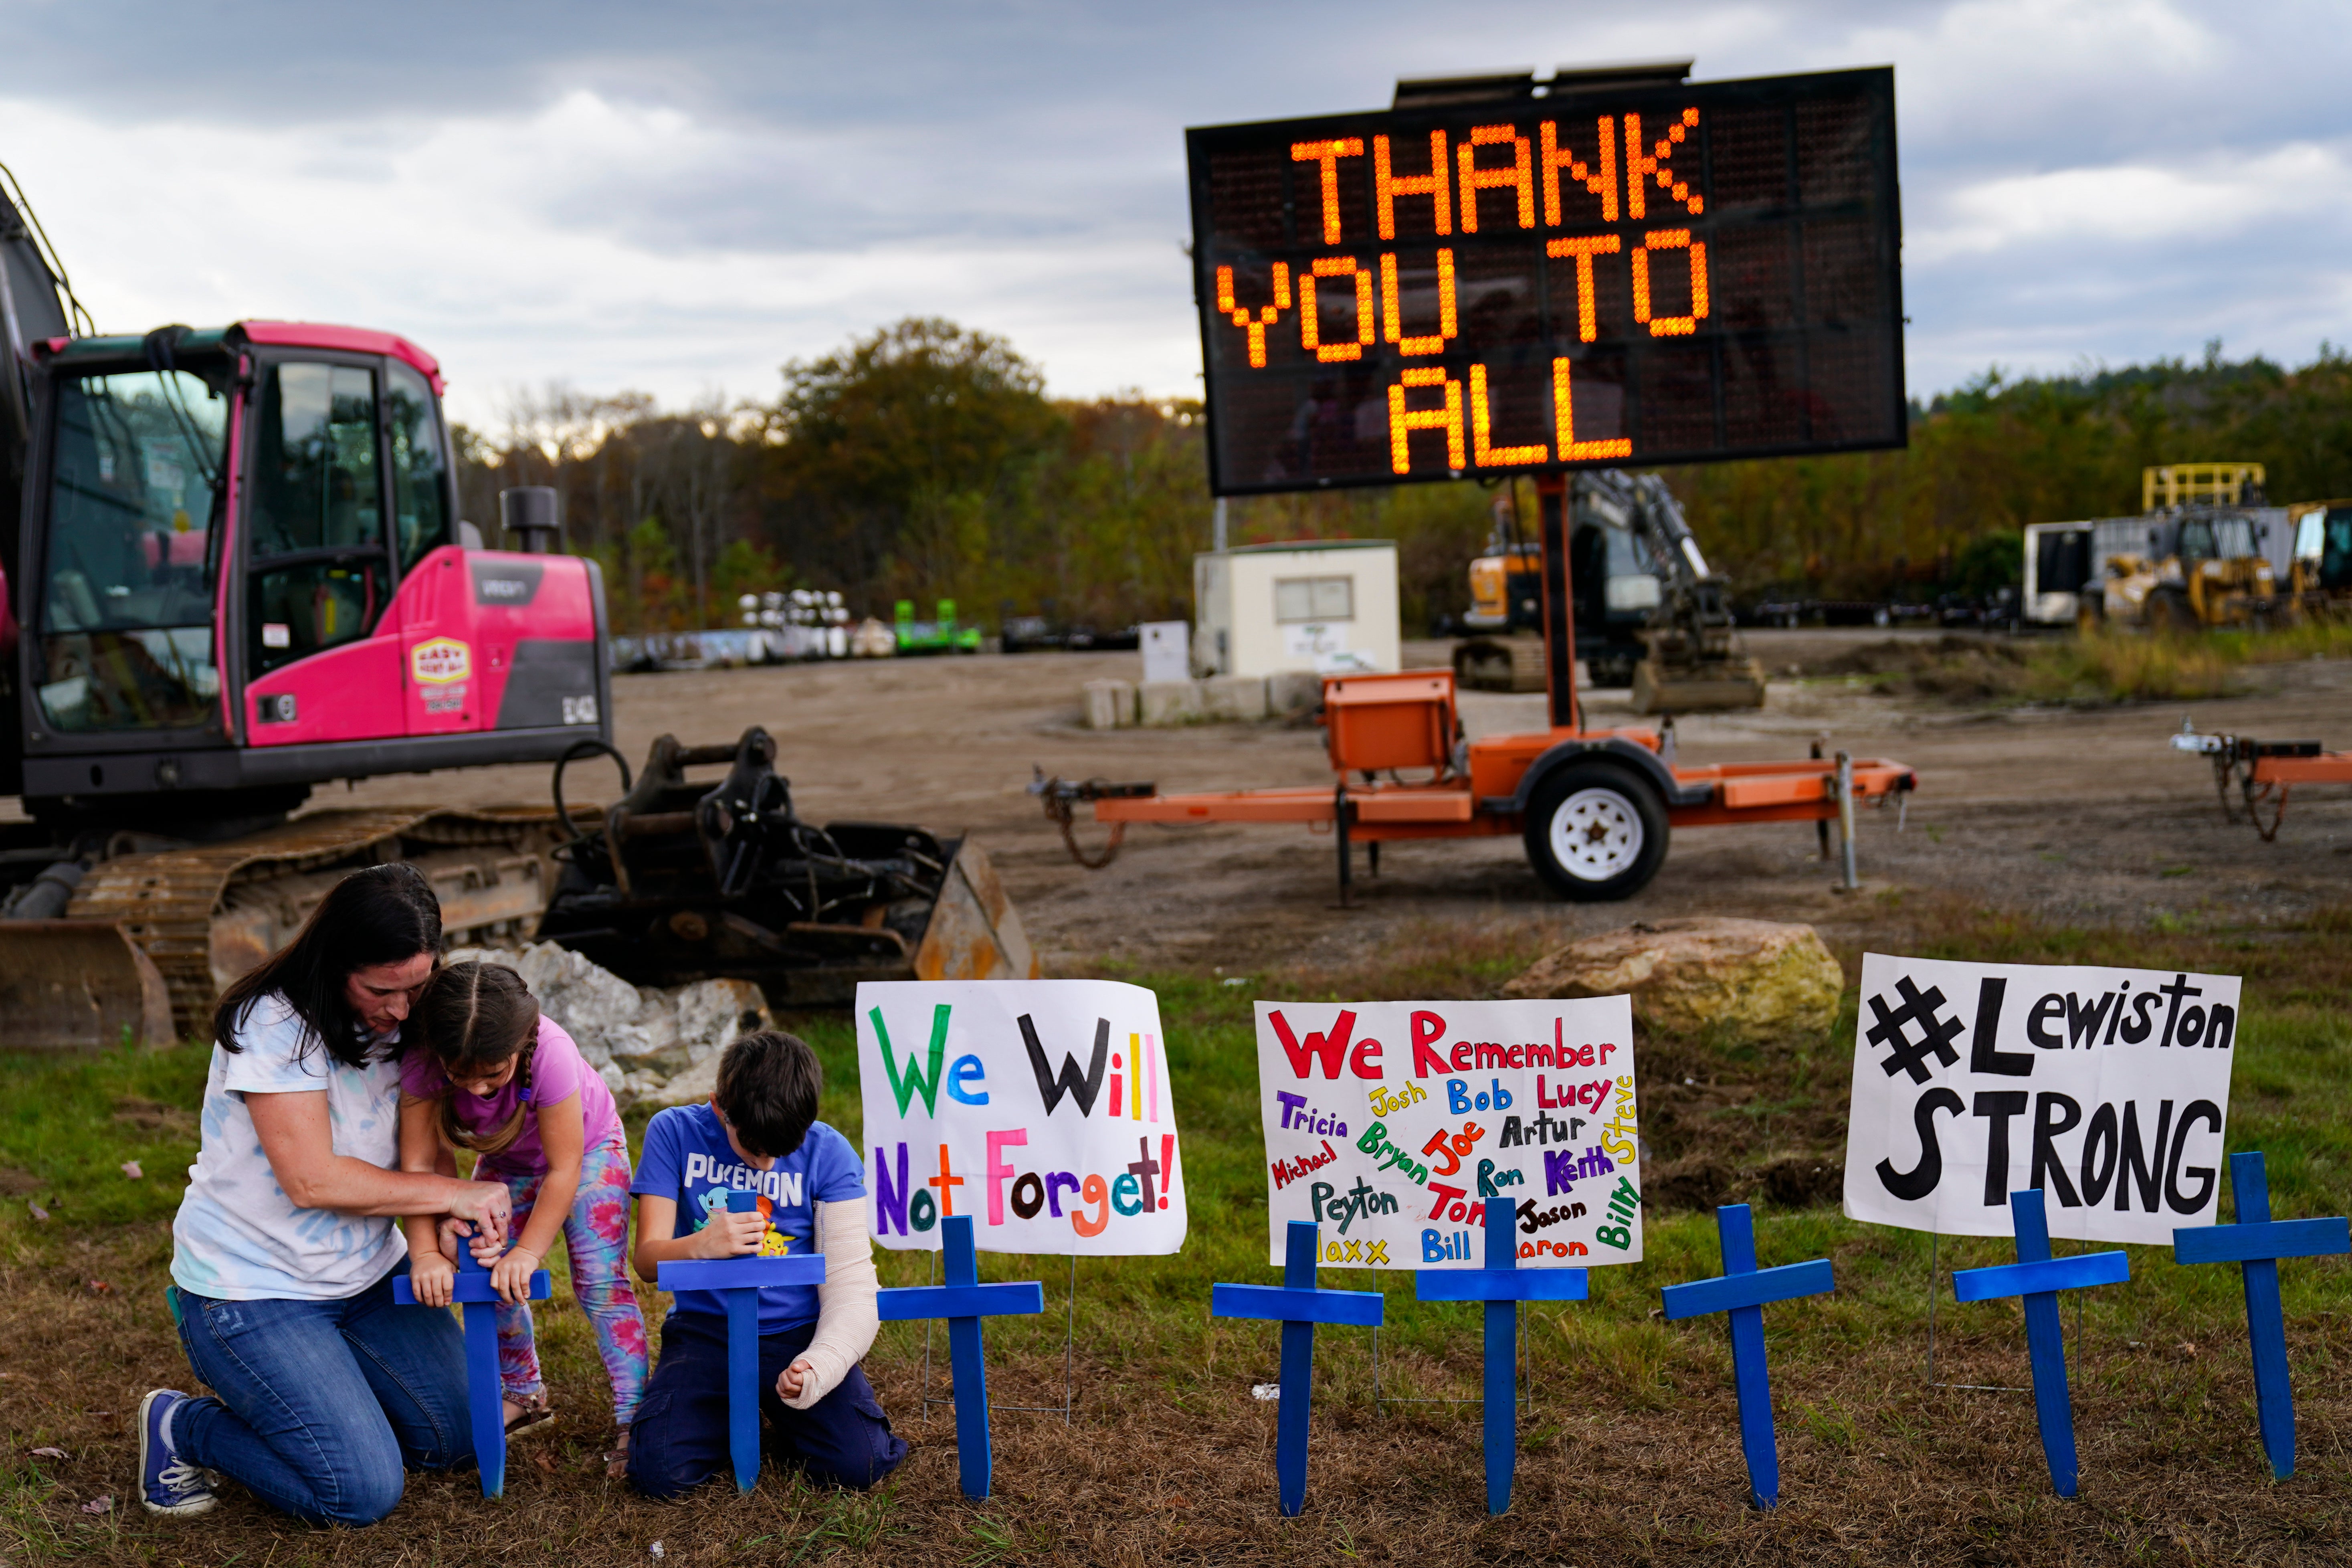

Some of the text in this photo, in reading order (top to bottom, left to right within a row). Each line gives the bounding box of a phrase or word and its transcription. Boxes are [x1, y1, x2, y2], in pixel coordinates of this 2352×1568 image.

[1291, 107, 1704, 245] THANK
[1216, 228, 1709, 369] YOU TO
[1388, 356, 1633, 475] ALL
[1268, 1009, 1616, 1079] We Remember
[1865, 974, 2235, 1085] #Lewiston
[868, 1004, 1158, 1122] We Will
[1277, 1090, 1348, 1137] Tricia
[1368, 1080, 1427, 1117] Josh
[1446, 1078, 1513, 1114] Bob
[1537, 1074, 1612, 1114] Lucy
[1600, 1075, 1637, 1164] Steve
[1356, 1121, 1428, 1185] Bryan
[1422, 1121, 1485, 1176] Joe
[1499, 1110, 1586, 1148] Artur
[1875, 1087, 2222, 1215] STRONG
[875, 1128, 1174, 1238] Not Forget!
[1271, 1140, 1337, 1190] Michael
[1477, 1158, 1524, 1197] Ron
[1543, 1146, 1614, 1196] Keith
[1311, 1176, 1399, 1235] Peyton
[1516, 1198, 1587, 1234] Jason
[1596, 1176, 1641, 1250] Billy
[1422, 1229, 1471, 1262] Bill
[1516, 1240, 1588, 1259] aron
